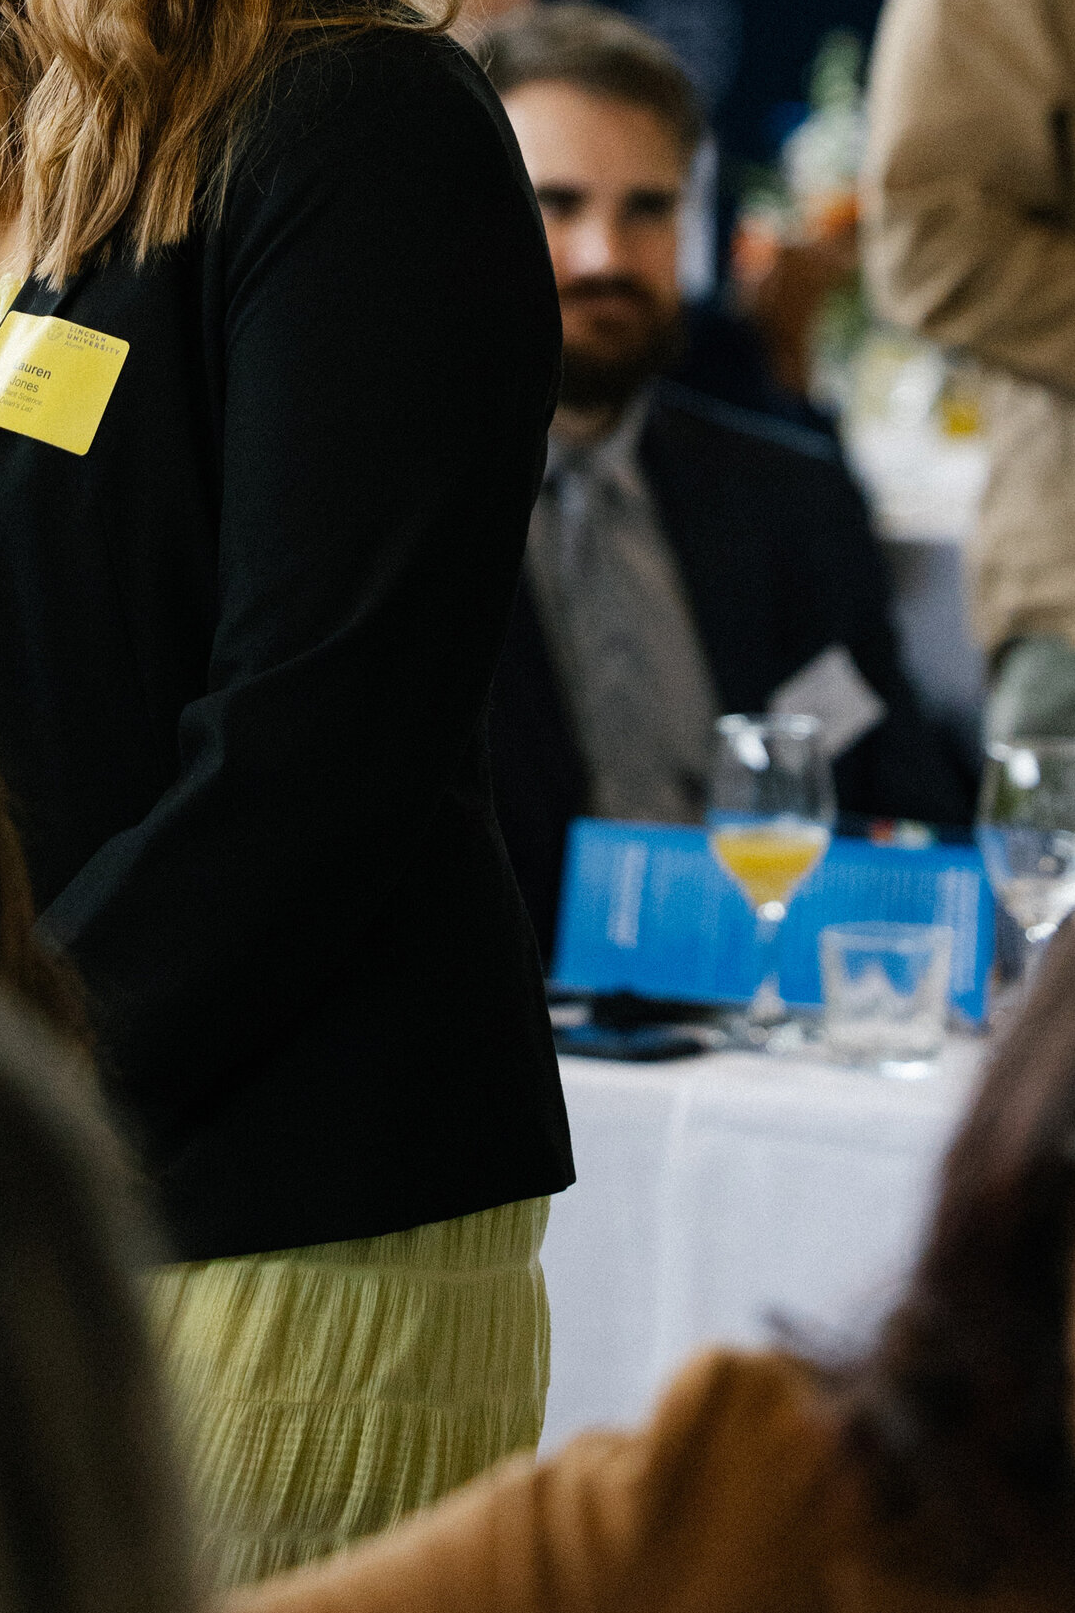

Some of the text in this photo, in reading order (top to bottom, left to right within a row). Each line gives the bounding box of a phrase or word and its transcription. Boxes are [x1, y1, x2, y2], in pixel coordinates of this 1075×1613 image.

[69, 325, 107, 343] LINCOLN
[66, 333, 121, 356] UNIVERSITY
[10, 375, 39, 393] Jones
